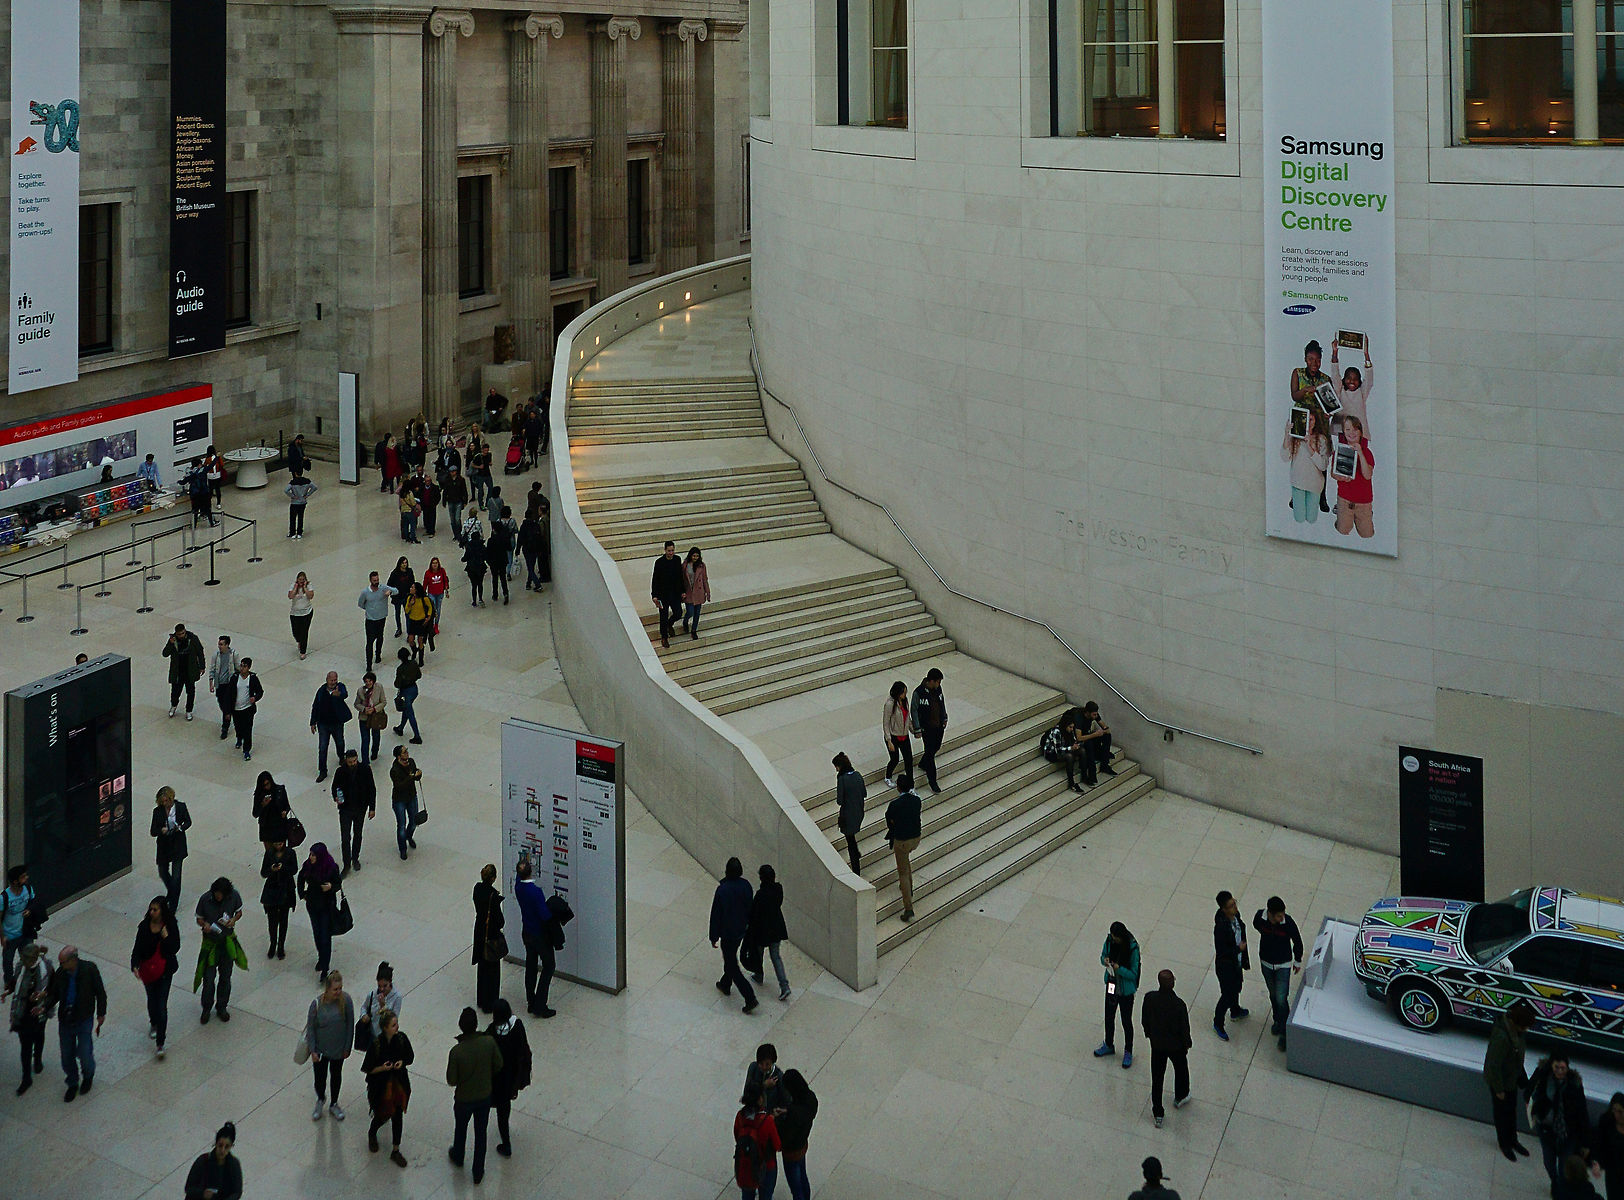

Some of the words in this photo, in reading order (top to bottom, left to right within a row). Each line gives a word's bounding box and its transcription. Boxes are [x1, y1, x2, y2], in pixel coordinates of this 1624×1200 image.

[1280, 135, 1384, 161] Samsung
[1281, 161, 1349, 184] Digital
[1281, 185, 1388, 212] Discovery
[175, 203, 193, 212] British
[193, 202, 215, 210] Museum
[1281, 210, 1352, 233] Centre
[1304, 247, 1334, 256] discover
[1335, 249, 1349, 257] and
[1281, 256, 1304, 264] create
[1305, 256, 1320, 264] with
[1321, 257, 1336, 265] free
[1337, 259, 1369, 268] sessions
[1282, 263, 1292, 271] for
[1322, 265, 1350, 275] families
[1281, 274, 1303, 283] young
[1304, 275, 1329, 284] people
[175, 286, 205, 300] Audio
[176, 300, 204, 316] guide
[18, 311, 55, 327] Family
[17, 327, 51, 345] guide
[14, 431, 32, 439] Audio
[50, 692, 58, 707] on
[48, 708, 58, 748] What's
[1428, 760, 1450, 770] South
[1450, 763, 1471, 773] Africa
[1434, 776, 1457, 785] nation
